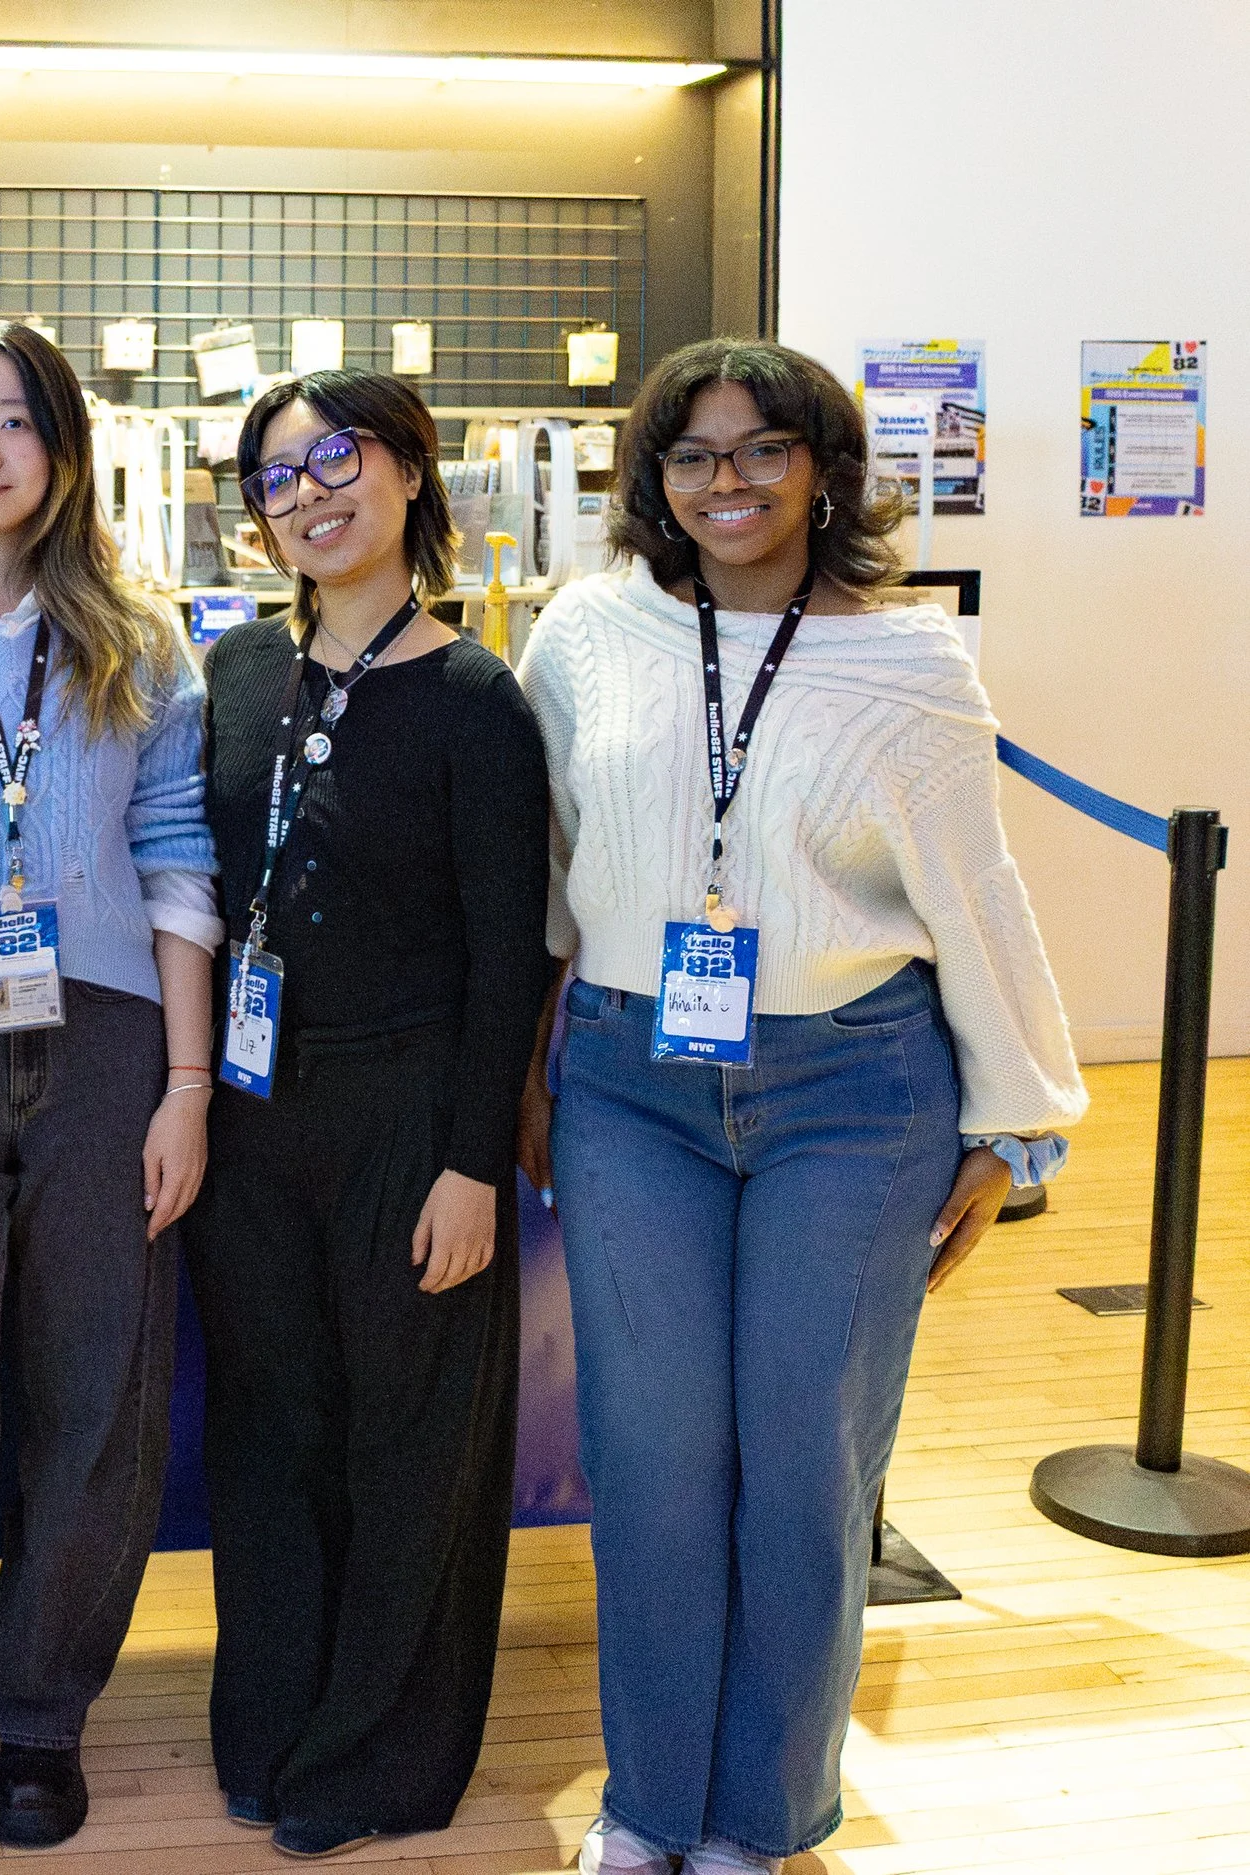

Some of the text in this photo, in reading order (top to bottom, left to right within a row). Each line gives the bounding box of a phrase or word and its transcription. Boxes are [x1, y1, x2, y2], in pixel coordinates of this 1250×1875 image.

[1173, 356, 1198, 370] 82
[874, 427, 929, 435] GREETINGS
[708, 702, 723, 799] hello82 STAFF
[14, 754, 29, 783] NYC
[271, 754, 286, 806] hello82
[268, 807, 280, 848] STAFF
[690, 938, 732, 949] hello
[686, 955, 732, 979] 82
[688, 1042, 716, 1053] NYC
